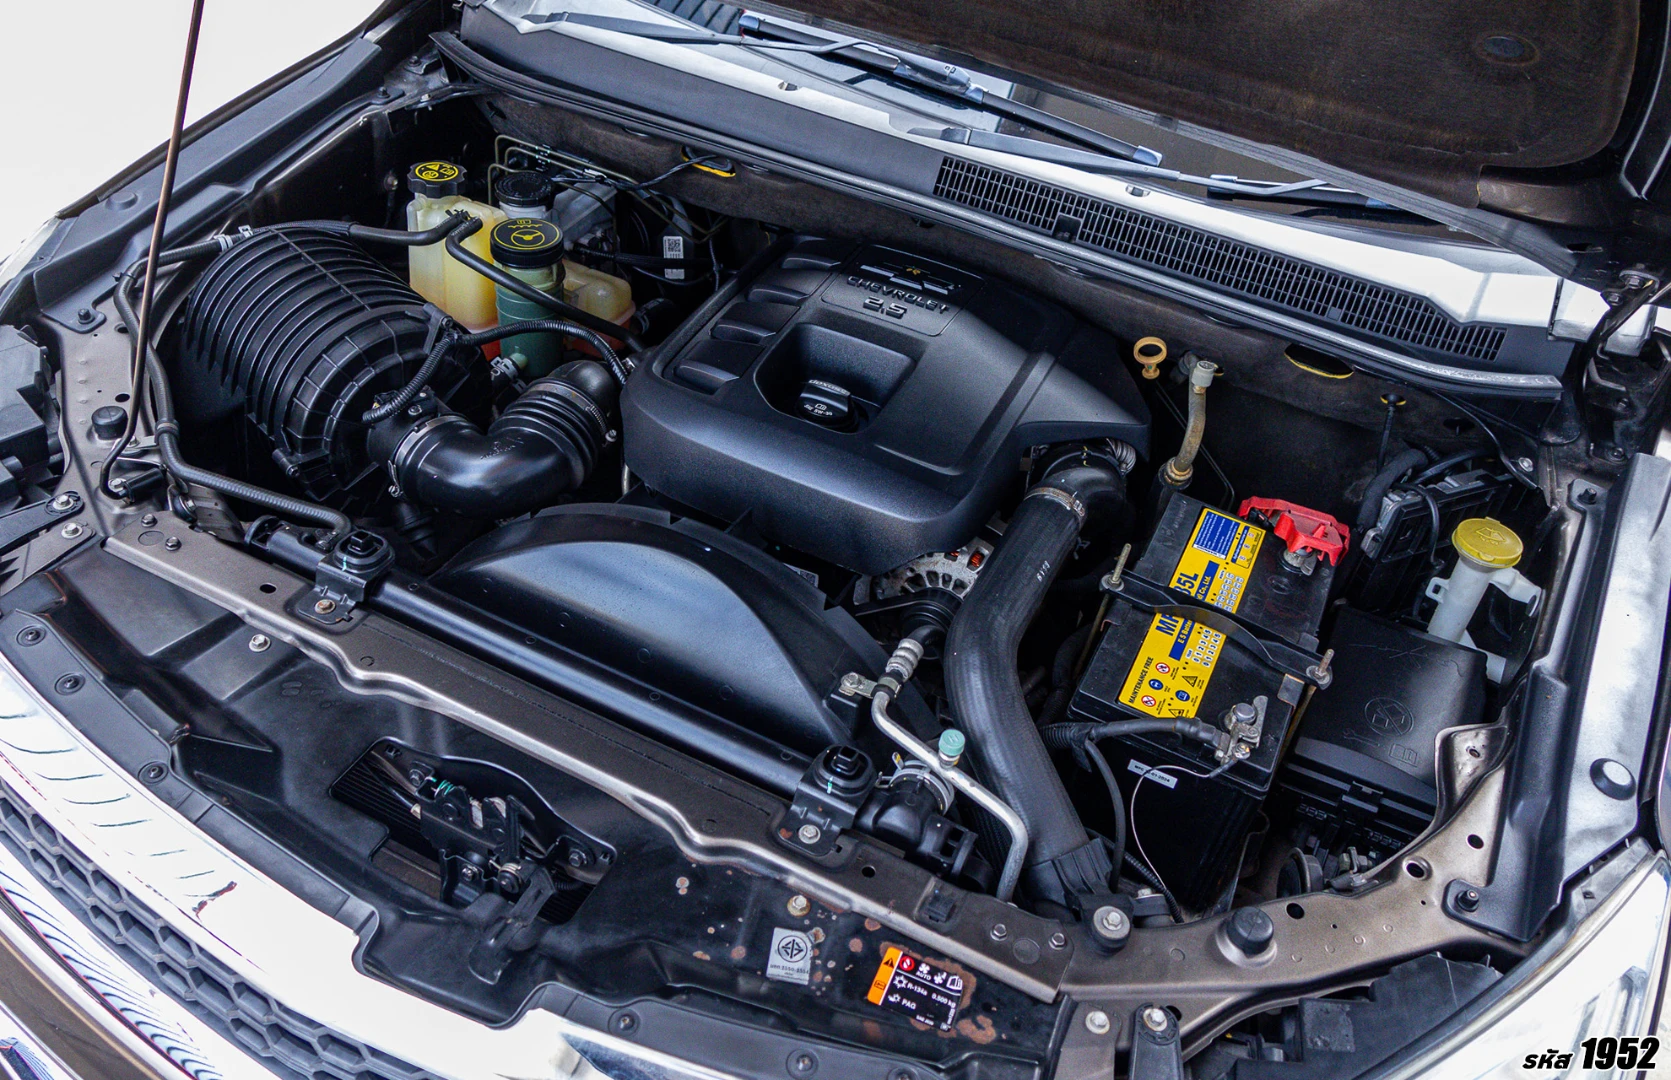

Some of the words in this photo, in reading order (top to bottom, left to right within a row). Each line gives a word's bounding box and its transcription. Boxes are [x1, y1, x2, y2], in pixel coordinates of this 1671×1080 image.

[848, 276, 949, 314] CHEVROLET
[863, 296, 907, 319] 2.5
[1128, 670, 1148, 704] MAINTENANCE
[1144, 656, 1153, 671] FREE
[916, 971, 931, 980] AUTO
[907, 982, 928, 995] R-134a
[902, 998, 916, 1009] PAG
